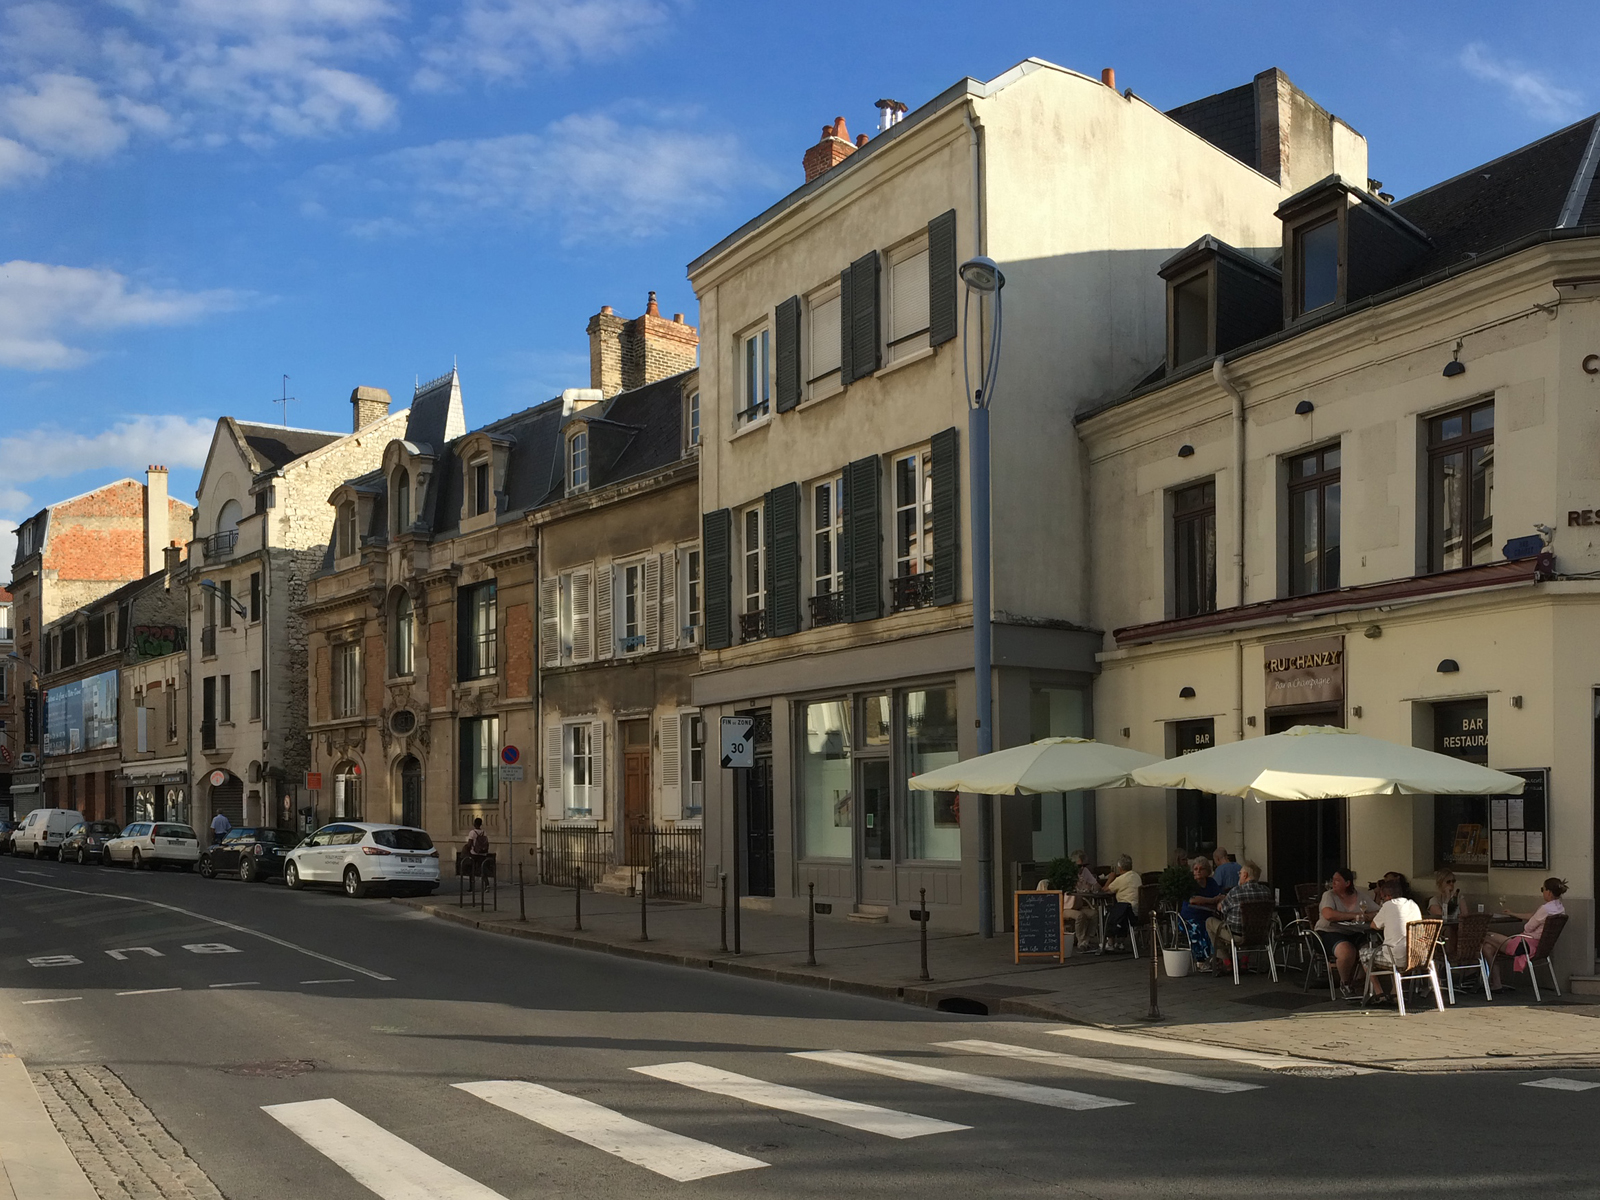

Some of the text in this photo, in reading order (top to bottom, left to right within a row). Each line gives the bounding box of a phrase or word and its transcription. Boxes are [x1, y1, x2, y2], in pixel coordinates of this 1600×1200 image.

[1289, 651, 1341, 669] CHANZY
[1275, 680, 1286, 690] Bar
[1293, 677, 1331, 690] Champagne
[1462, 718, 1484, 731] BAR
[1195, 734, 1210, 745] BAR
[731, 742, 744, 754] 30
